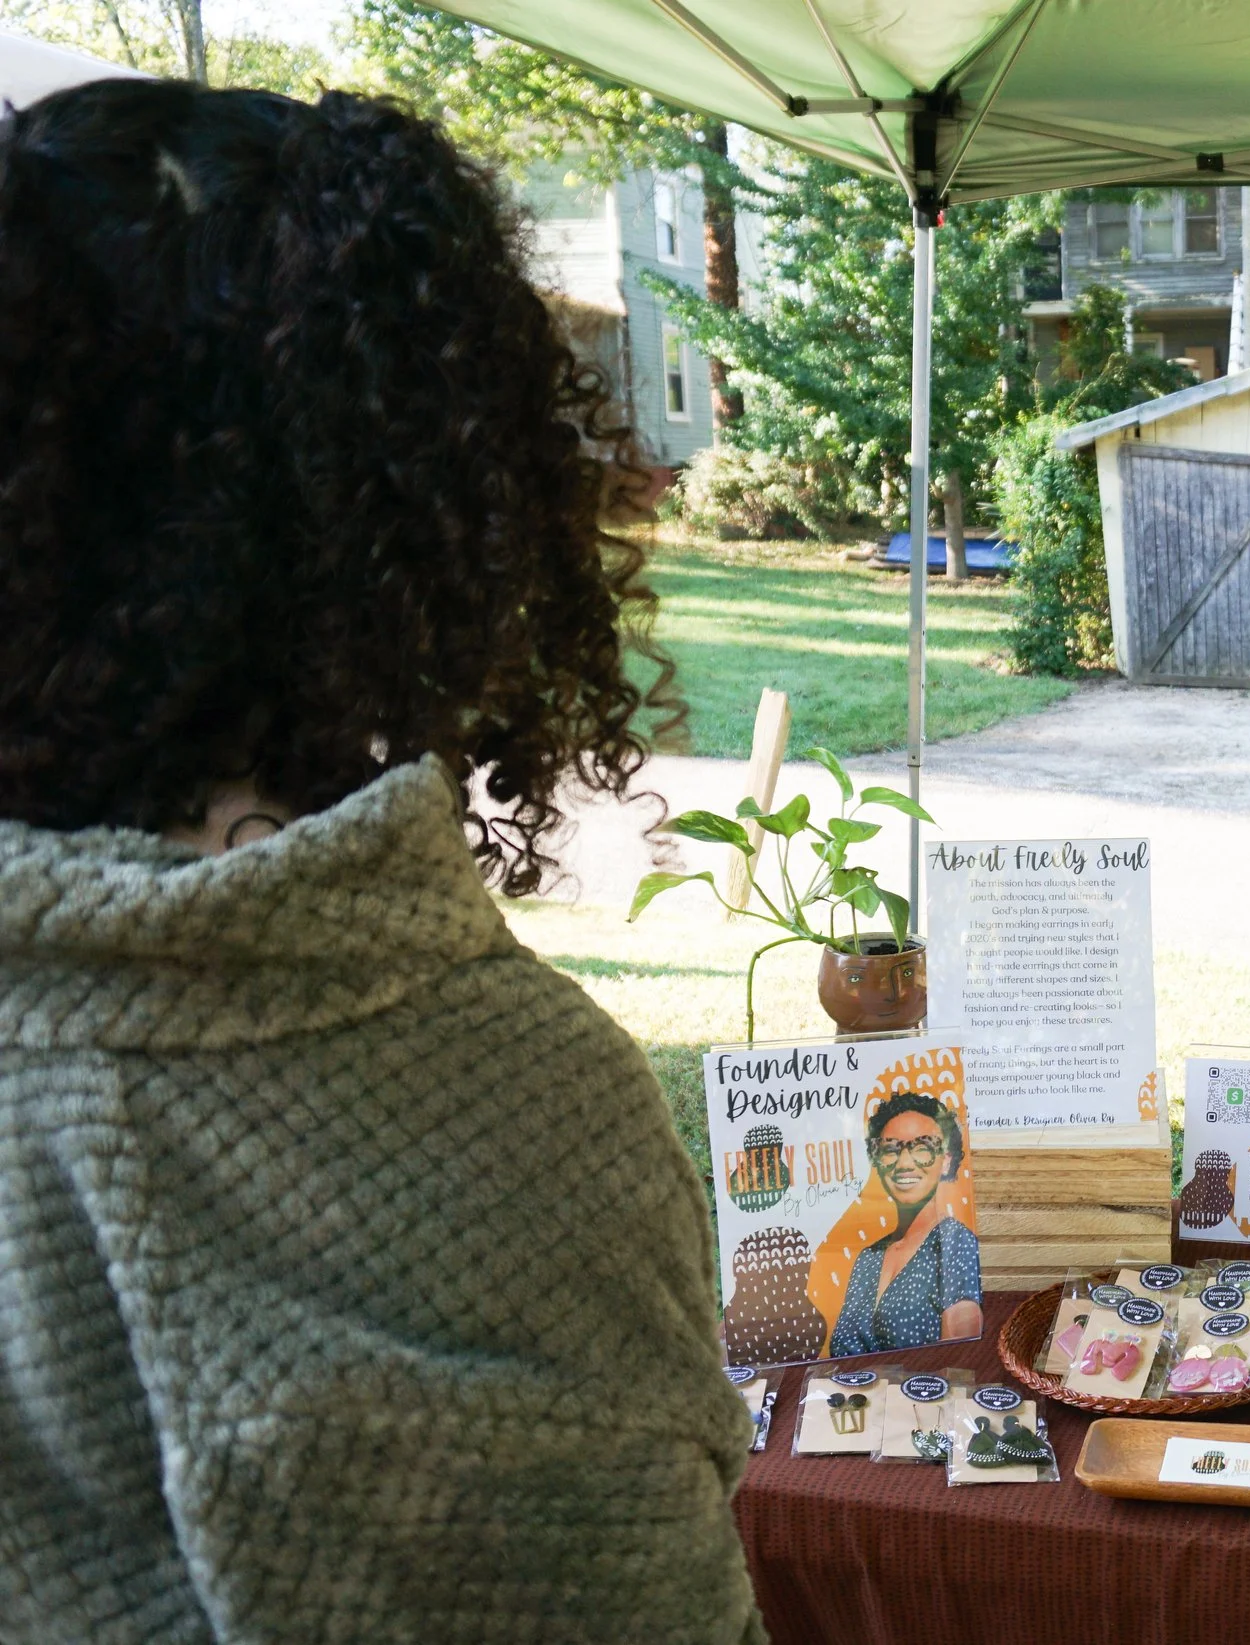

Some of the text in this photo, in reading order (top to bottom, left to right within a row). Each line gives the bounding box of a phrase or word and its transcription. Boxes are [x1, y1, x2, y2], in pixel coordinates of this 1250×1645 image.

[929, 842, 1149, 874] About Freely Soul
[1025, 879, 1042, 887] has
[1044, 879, 1076, 889] always
[1078, 879, 1100, 887] been
[969, 893, 998, 903] youth,
[1001, 893, 1046, 902] advocacy,
[992, 907, 1017, 915] God's
[1019, 906, 1039, 917] plan
[1050, 907, 1089, 916] purpose.
[975, 920, 1114, 931] began making earrings in early
[999, 934, 1015, 942] and
[1018, 934, 1044, 944] trying
[1068, 933, 1093, 943] styles
[1096, 933, 1114, 941] that
[1004, 949, 1033, 958] people
[1090, 947, 1118, 956] design
[1023, 961, 1060, 971] earrings
[1062, 961, 1081, 969] that
[996, 975, 1033, 983] different
[1036, 975, 1068, 985] shapes
[1071, 975, 1087, 983] and
[963, 988, 1123, 999] have always been passionate about
[964, 1004, 998, 1012] fashion
[1001, 1004, 1018, 1012] and
[1020, 1002, 1071, 1012] re-creating
[1073, 1002, 1096, 1010] looks
[971, 1018, 994, 1029] hope
[1042, 1017, 1066, 1025] these
[1068, 1016, 1112, 1025] treasures.
[962, 1046, 989, 1056] Freely
[1079, 1043, 1103, 1051] small
[1106, 1043, 1125, 1053] part
[715, 1047, 858, 1084] Founder &
[968, 1060, 977, 1068] of
[979, 1061, 1006, 1069] many
[1040, 1058, 1055, 1066] but
[1057, 1058, 1071, 1066] the
[1074, 1057, 1098, 1065] heart
[966, 1070, 1120, 1083] always empower young black and
[975, 1087, 1004, 1096] brown
[1007, 1086, 1026, 1096] girls
[1028, 1086, 1048, 1094] who
[1071, 1085, 1087, 1093] like
[727, 1086, 858, 1123] Designer
[975, 1117, 1012, 1127] Founder
[1070, 1113, 1096, 1124] Olivia
[724, 1139, 855, 1194] FREELY SOUL
[783, 1192, 802, 1217] By
[805, 1183, 839, 1207] Olivia
